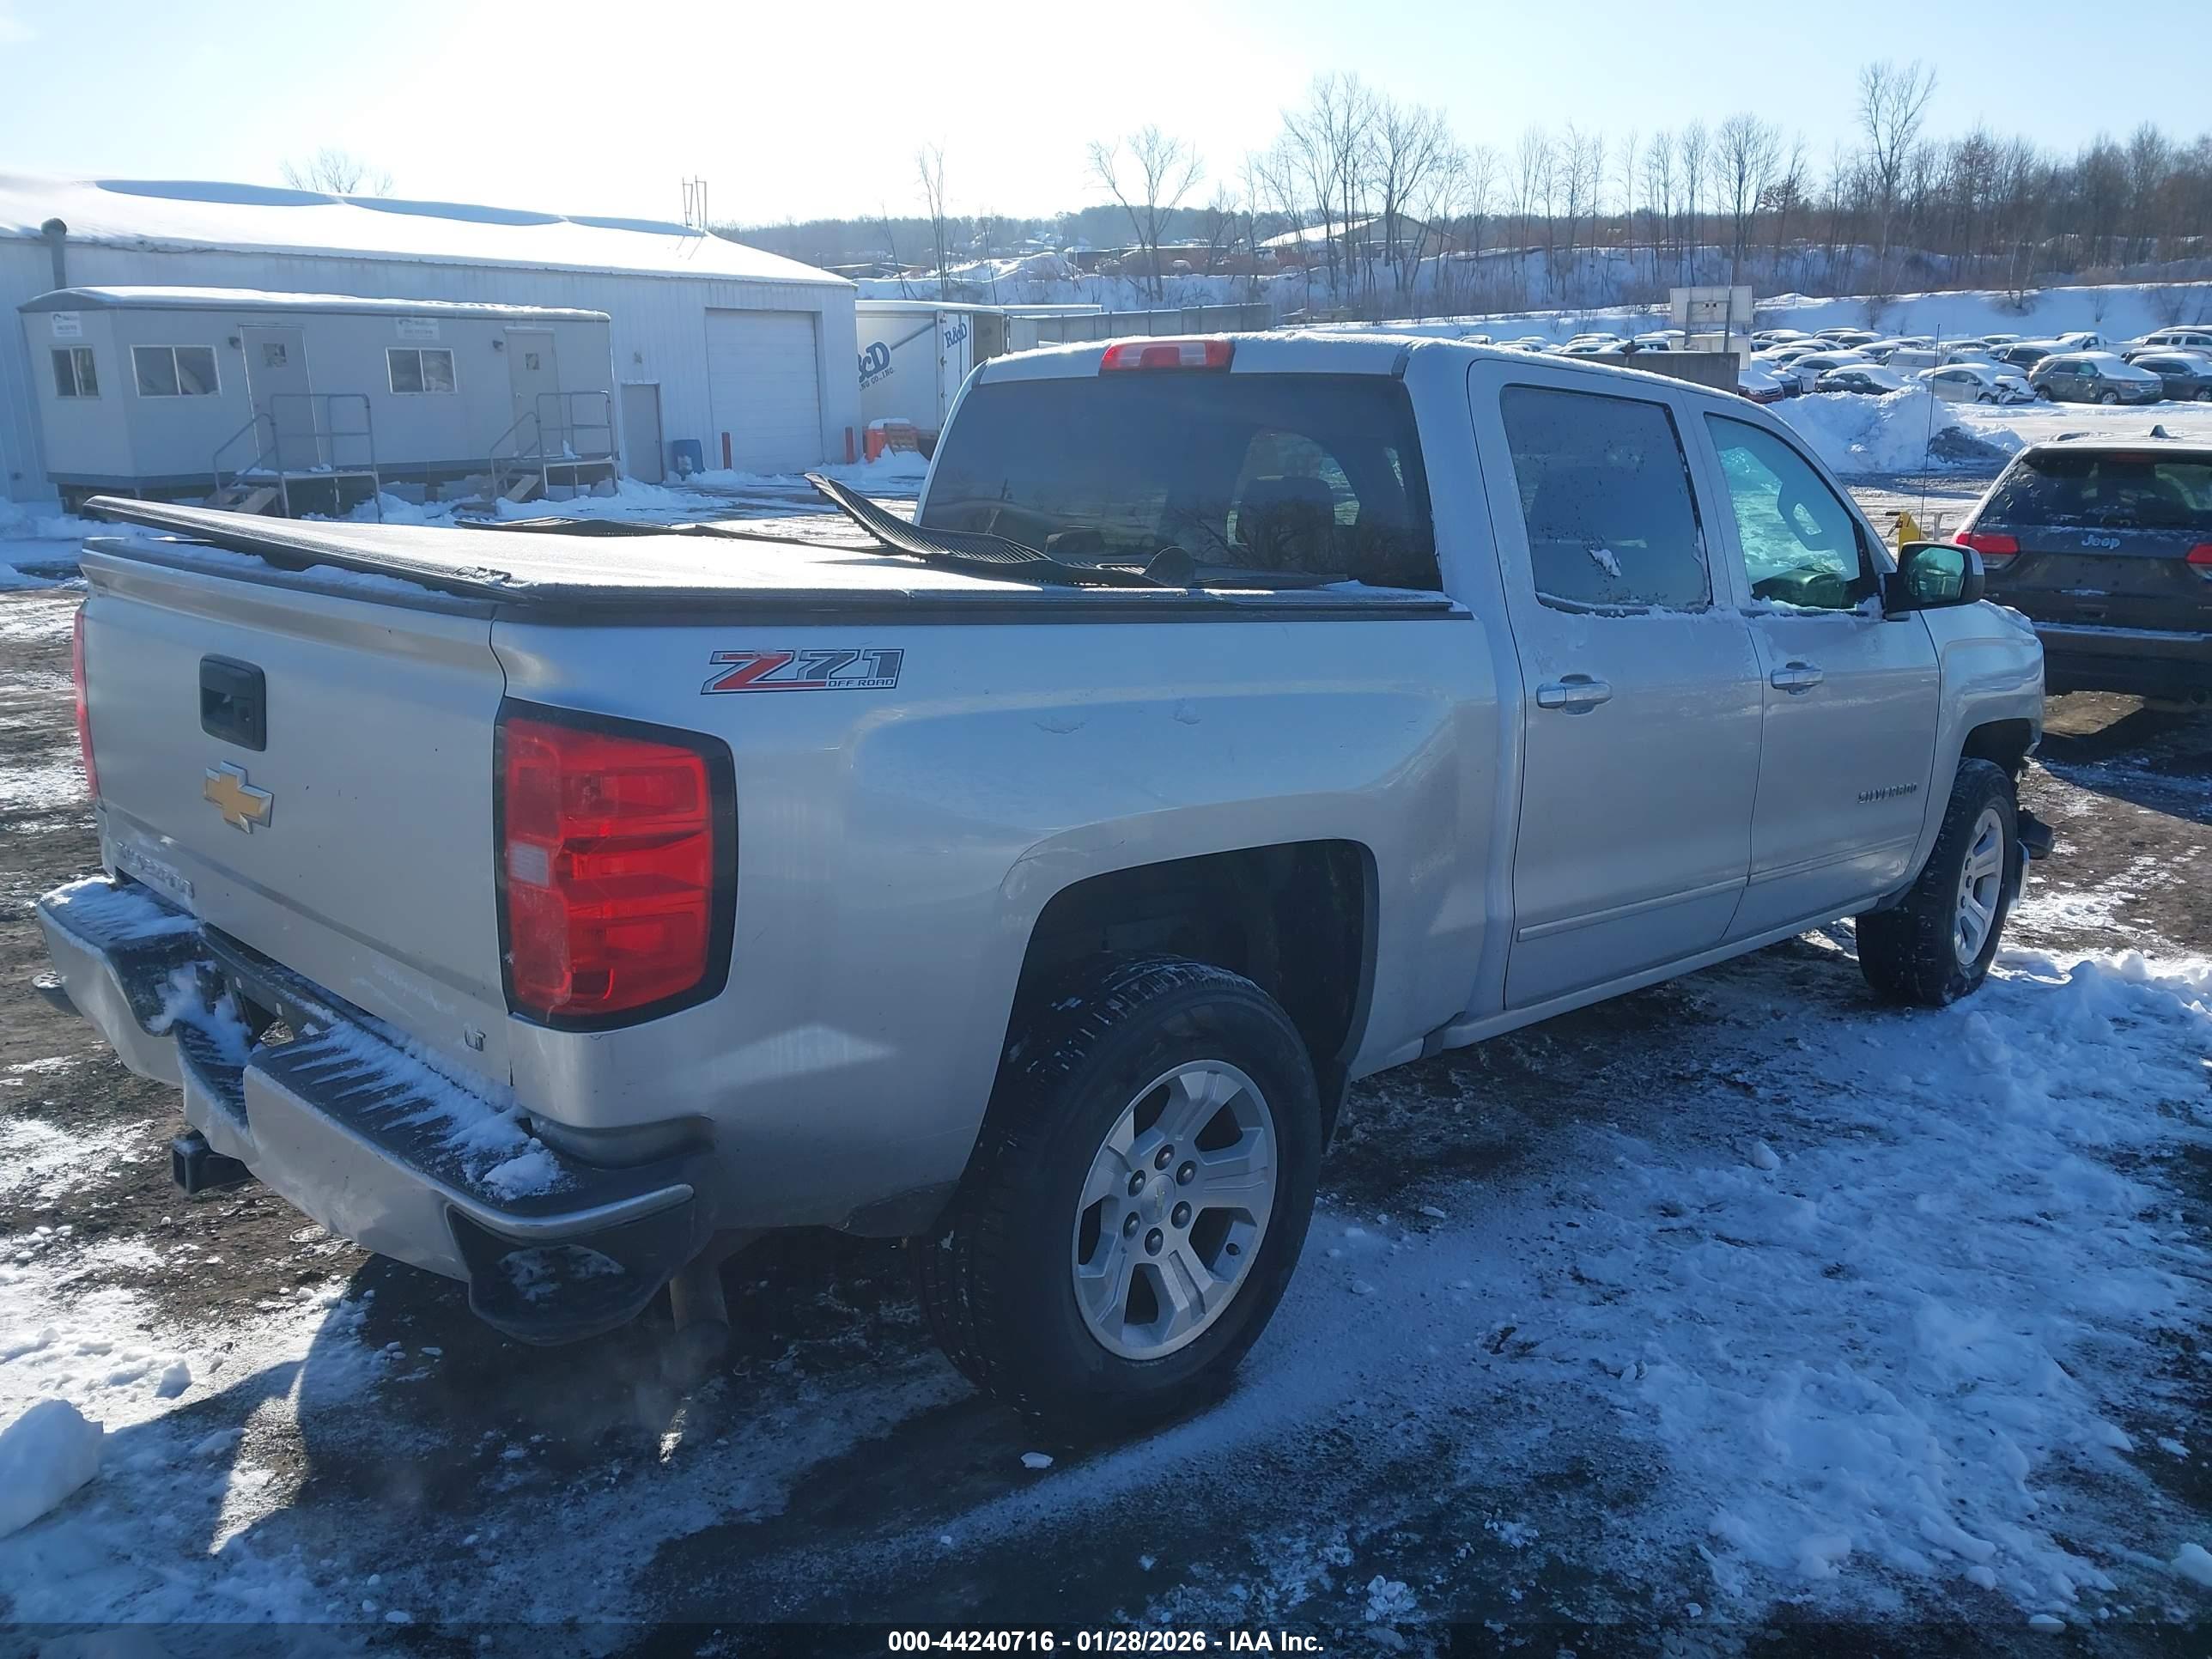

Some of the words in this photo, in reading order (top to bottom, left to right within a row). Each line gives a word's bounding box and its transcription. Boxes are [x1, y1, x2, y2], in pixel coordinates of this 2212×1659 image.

[945, 323, 968, 349] R&D
[858, 342, 890, 383] &D
[2081, 534, 2121, 550] Jeep
[701, 648, 905, 695] Z71
[828, 679, 855, 688] OFF
[857, 678, 894, 687] ROAD
